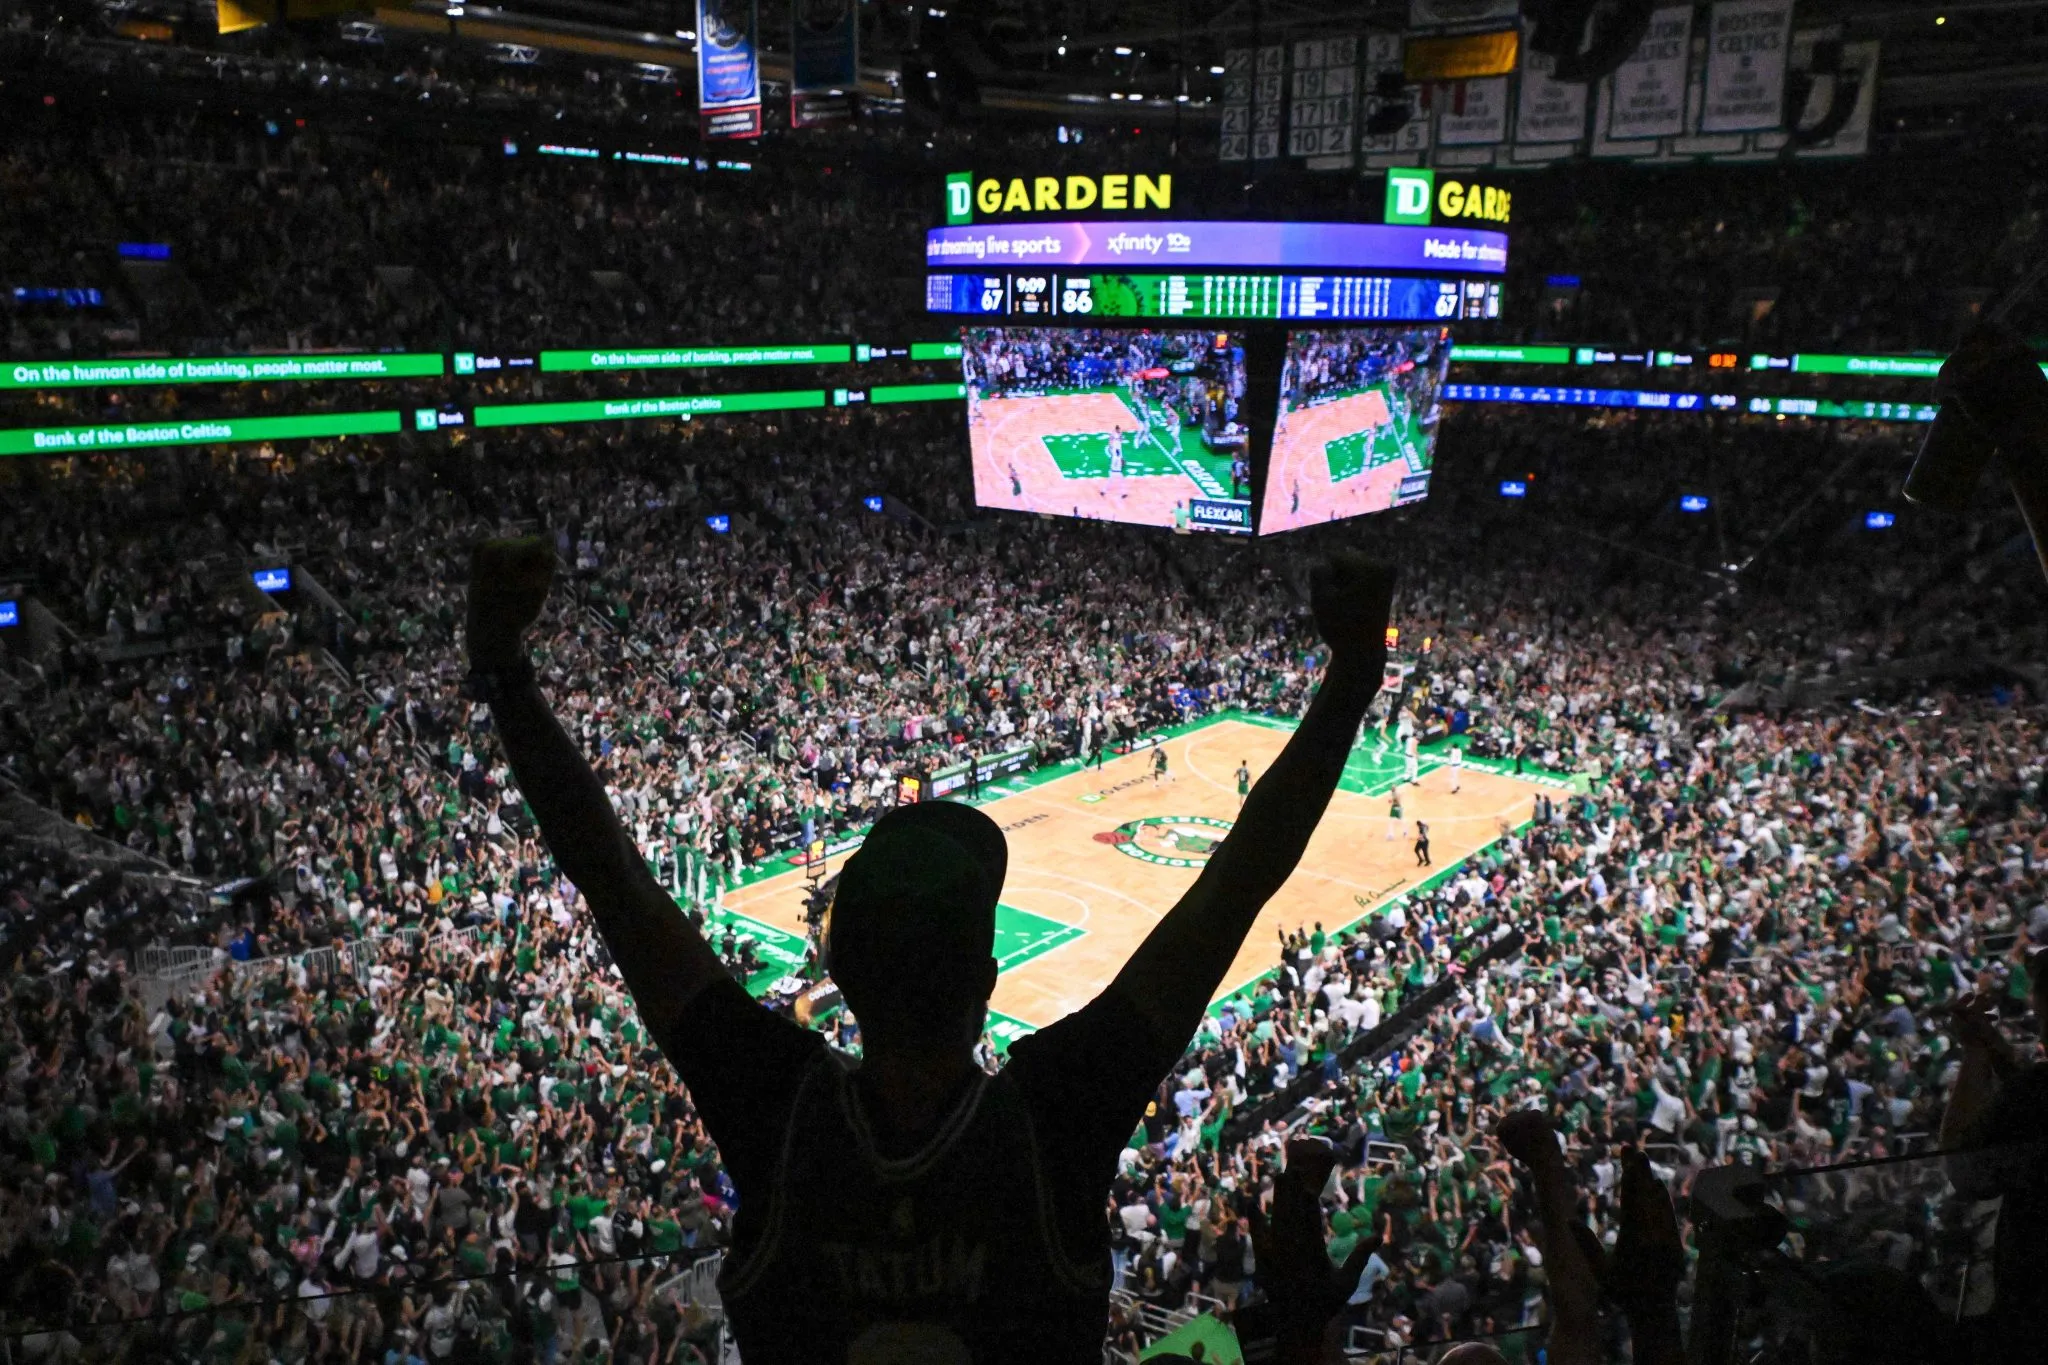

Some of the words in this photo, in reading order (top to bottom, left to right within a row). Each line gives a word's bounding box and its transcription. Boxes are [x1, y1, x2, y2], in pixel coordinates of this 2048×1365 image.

[1293, 132, 1318, 153] 10
[1328, 128, 1346, 151] 2
[976, 174, 1171, 214] GARDEN
[1391, 176, 1430, 216] TD
[1438, 180, 1510, 223] GARD
[986, 235, 1010, 255] live
[1011, 235, 1061, 259] sports
[1105, 232, 1162, 257] xfinity
[1424, 238, 1461, 259] Made
[1016, 277, 1047, 293] 9:09
[981, 289, 1004, 311] 67
[1062, 290, 1093, 313] 86
[1435, 294, 1458, 317] 67
[477, 356, 501, 368] Bank
[591, 352, 607, 365] On
[608, 353, 625, 365] the
[626, 352, 660, 364] human
[661, 352, 681, 363] side
[681, 351, 692, 363] of
[692, 350, 731, 363] banking,
[732, 350, 762, 363] people
[763, 350, 791, 360] matter
[1847, 358, 1868, 370] On
[1869, 359, 1887, 371] the
[1888, 360, 1928, 372] human
[14, 366, 40, 382] On
[43, 365, 71, 381] the
[73, 364, 131, 380] human
[133, 363, 166, 378] side
[168, 362, 184, 377] of
[187, 361, 252, 378] banking,
[253, 360, 302, 377] people
[303, 361, 348, 373] matter
[350, 360, 387, 372] most.
[605, 403, 629, 415] Bank
[630, 402, 641, 413] of
[642, 401, 658, 412] the
[659, 400, 690, 412] Boston
[691, 398, 722, 410] Celtics
[1676, 395, 1698, 408] 67
[1750, 398, 1771, 412] 86
[1778, 399, 1818, 414] BOSTON
[439, 412, 464, 424] Bank
[34, 431, 76, 448] Bank
[77, 430, 95, 445] of
[97, 429, 123, 443] the
[126, 427, 180, 442] Boston
[181, 424, 232, 439] Celtics
[1193, 504, 1243, 522] FLEXCAR
